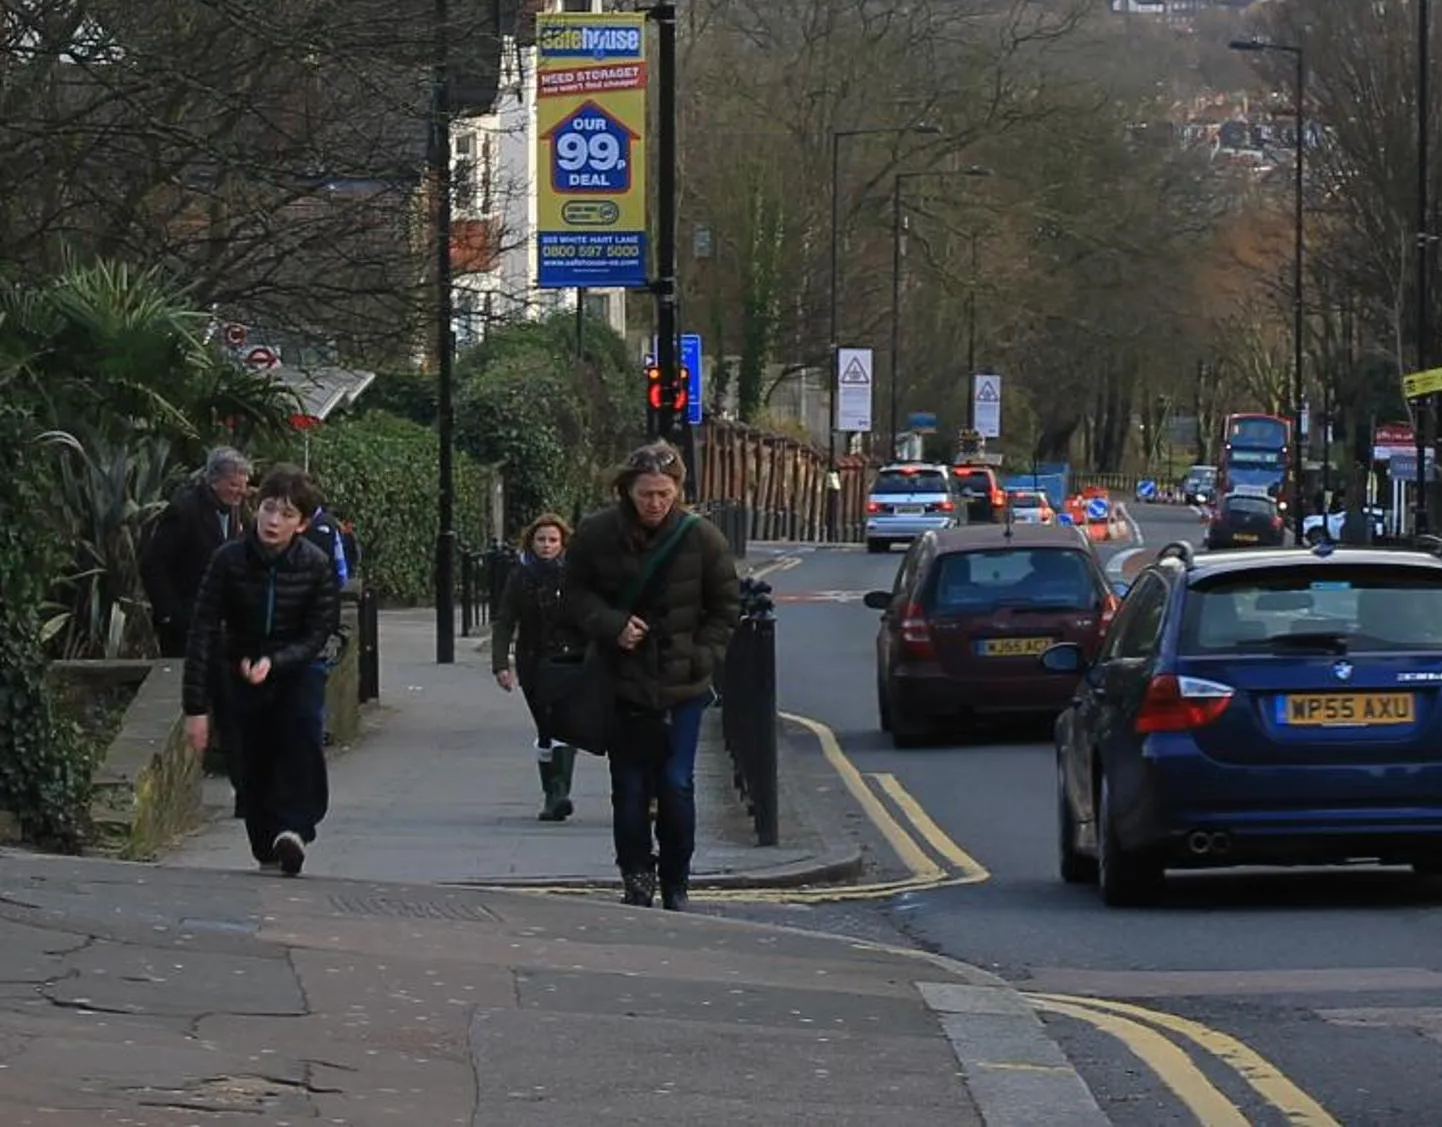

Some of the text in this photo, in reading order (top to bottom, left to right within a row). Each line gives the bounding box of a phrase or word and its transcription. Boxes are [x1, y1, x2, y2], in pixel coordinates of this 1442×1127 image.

[541, 73, 575, 85] NEED
[572, 117, 607, 131] OUR
[568, 174, 611, 186] DEAL
[559, 236, 588, 244] WHITE
[590, 236, 613, 244] HART
[615, 236, 639, 244] LANE
[543, 245, 576, 257] 0800
[607, 245, 640, 257] 5000
[1364, 697, 1409, 719] AXU
